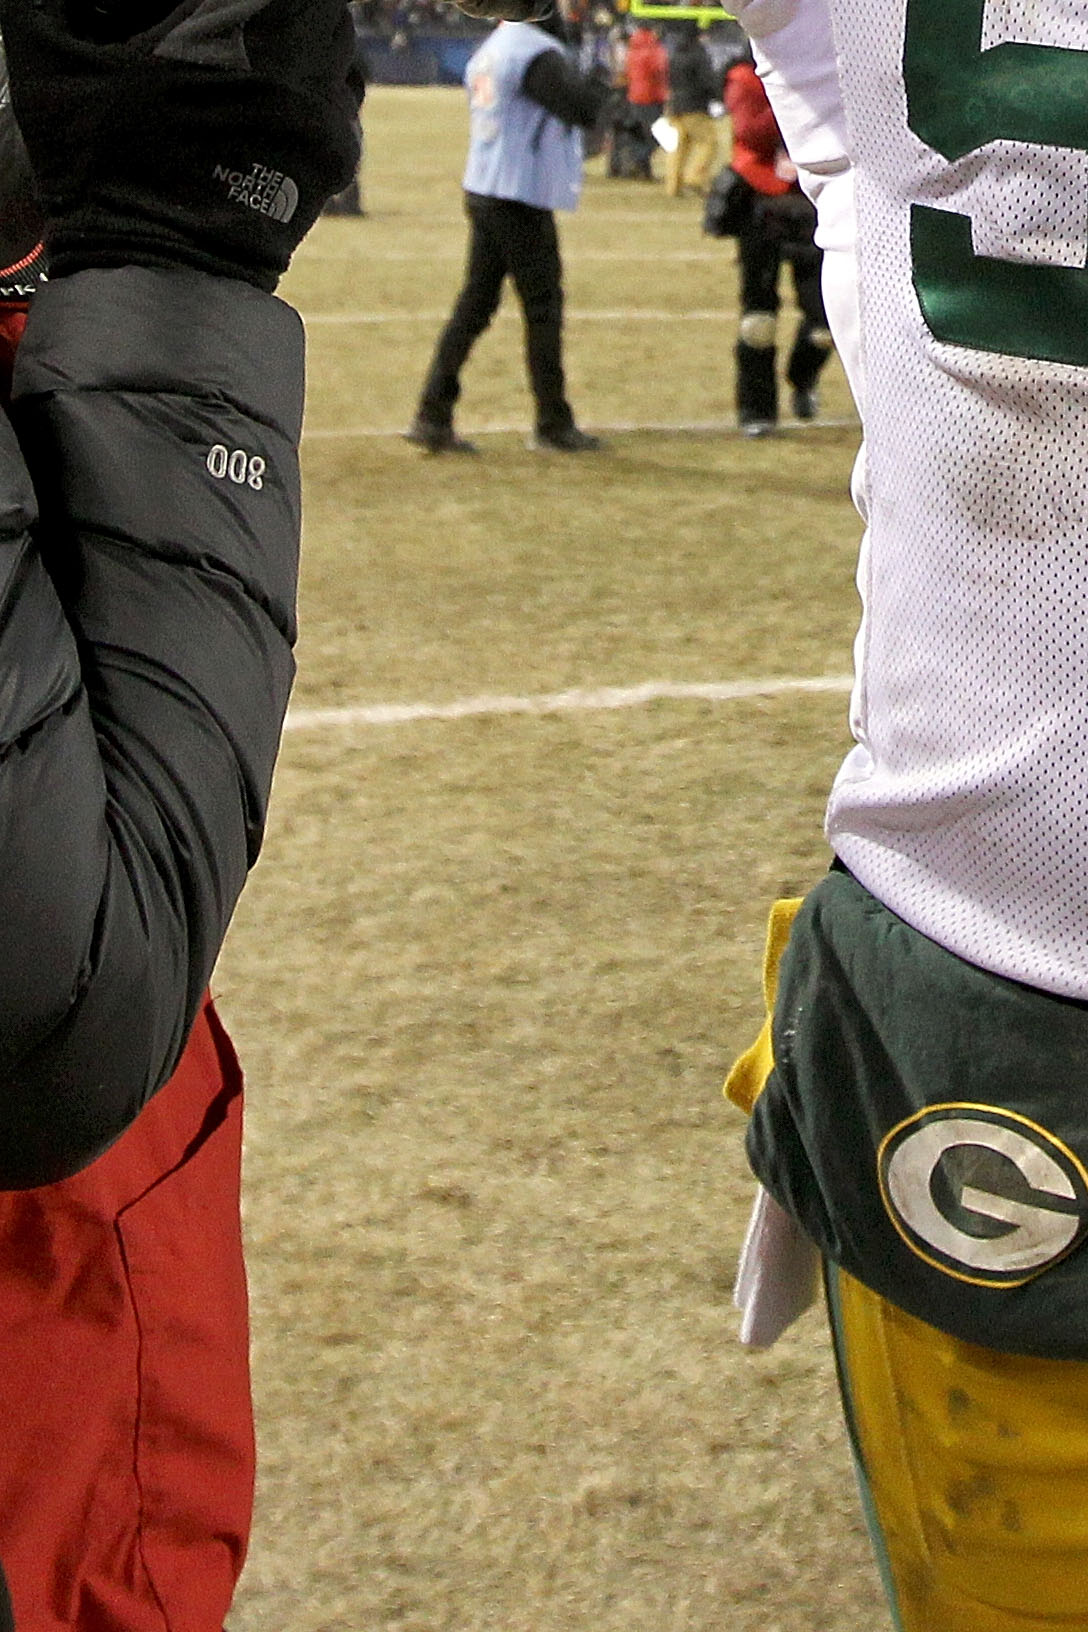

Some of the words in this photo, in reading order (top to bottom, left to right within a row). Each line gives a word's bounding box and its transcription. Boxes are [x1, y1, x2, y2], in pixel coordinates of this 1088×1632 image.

[212, 164, 281, 201] NORTH
[252, 163, 284, 187] THE
[227, 185, 272, 215] FACE
[886, 1117, 1080, 1273] G
